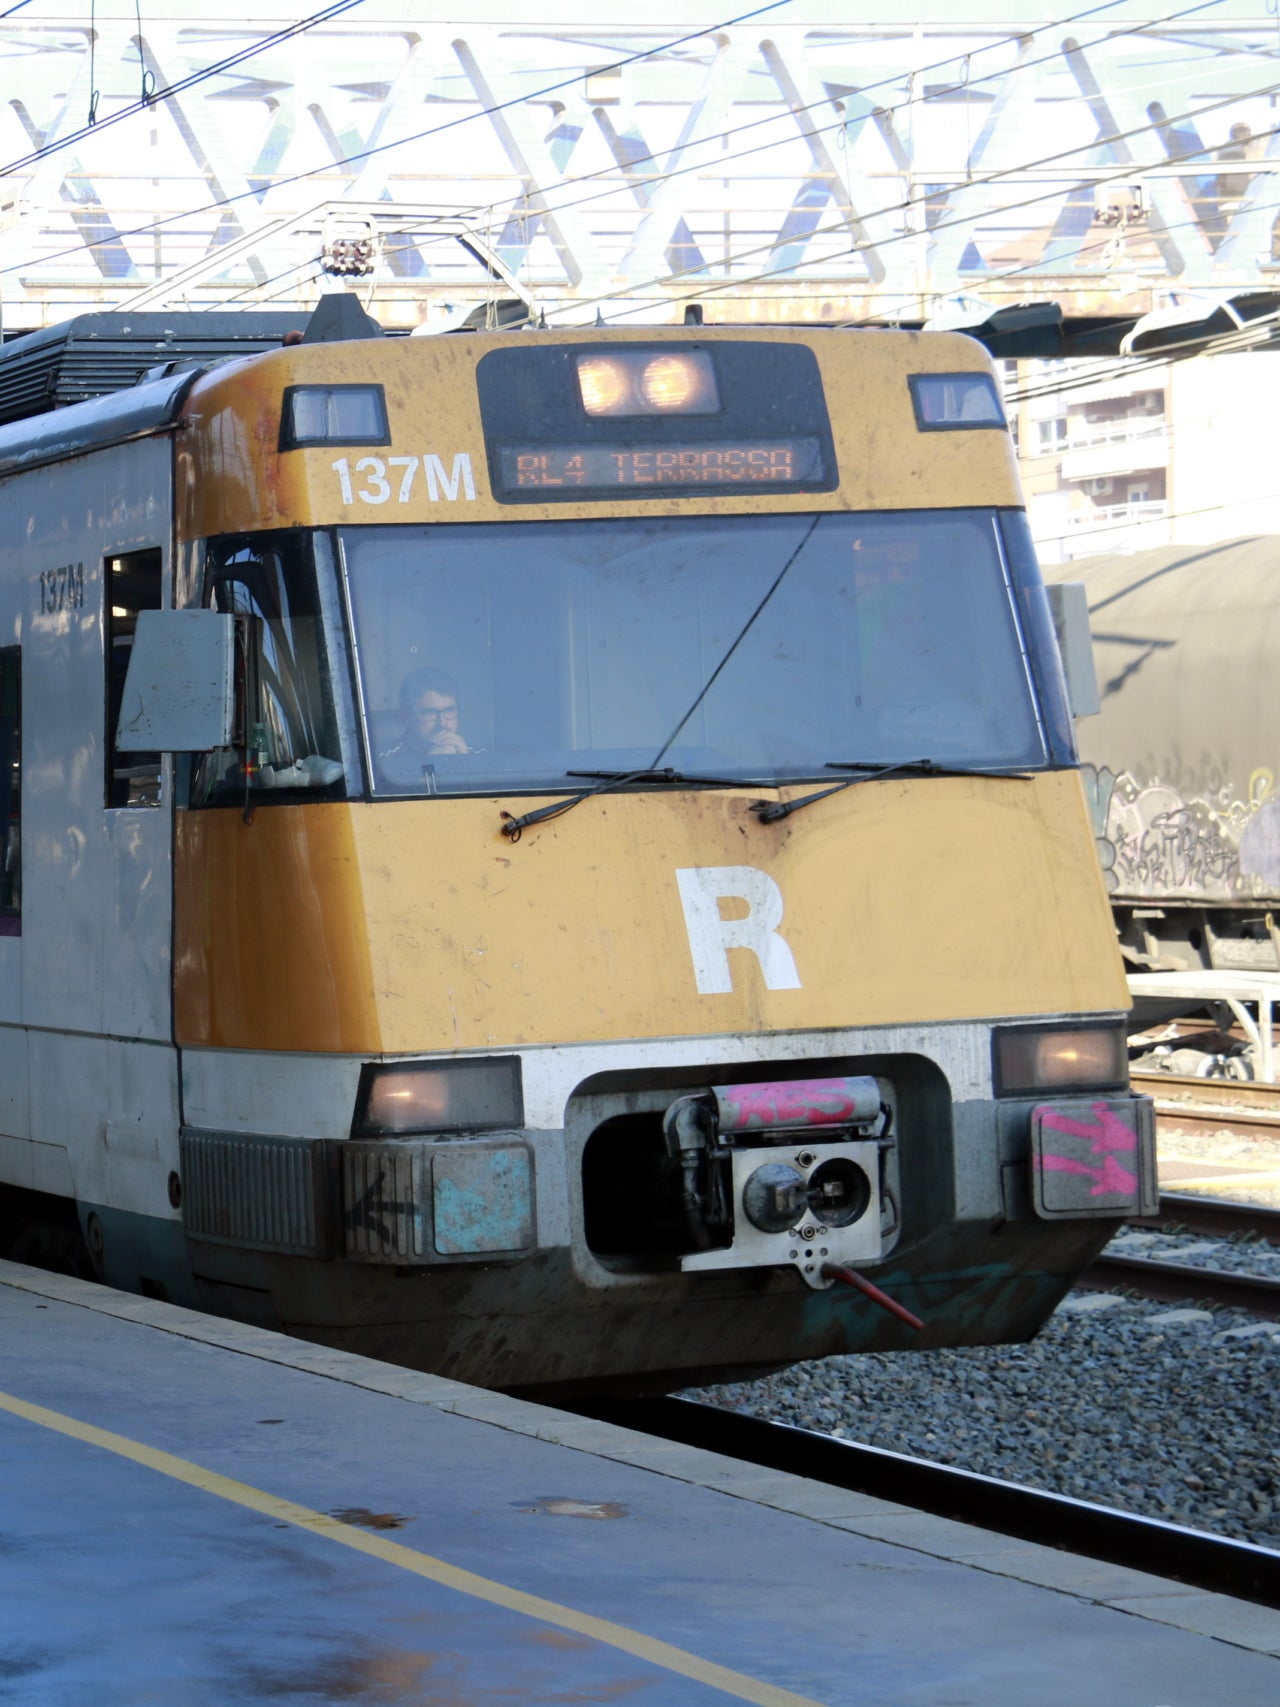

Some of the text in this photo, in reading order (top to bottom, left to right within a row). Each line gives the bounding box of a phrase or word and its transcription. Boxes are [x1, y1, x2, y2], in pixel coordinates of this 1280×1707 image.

[331, 453, 476, 504] 137M
[610, 449, 793, 483] TERRASSA
[39, 562, 84, 615] 137M
[675, 865, 803, 995] R
